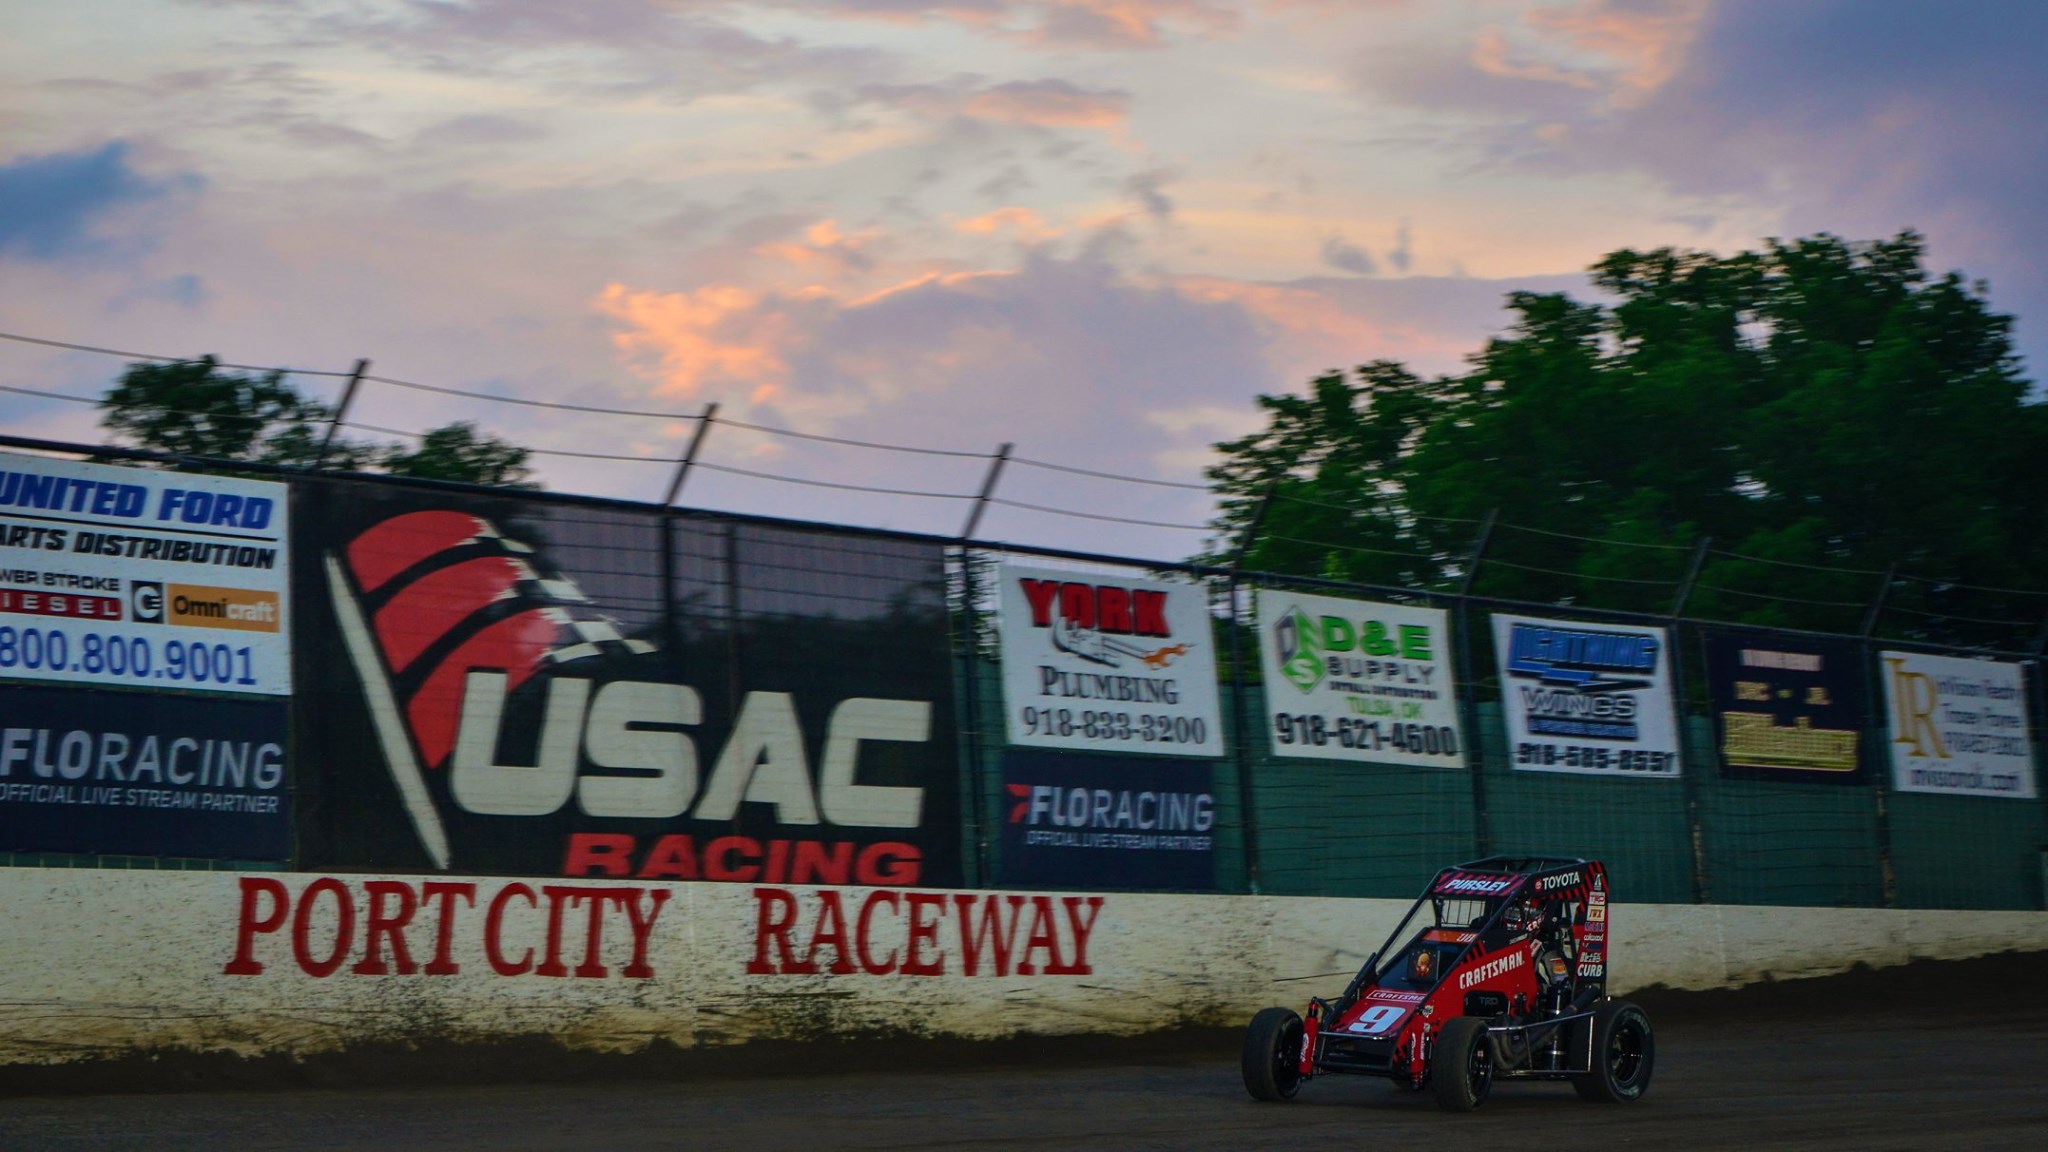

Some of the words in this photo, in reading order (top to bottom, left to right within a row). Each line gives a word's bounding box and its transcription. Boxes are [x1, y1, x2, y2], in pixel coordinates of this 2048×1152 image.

[157, 488, 273, 529] FORD
[73, 531, 277, 569] DISTRIBUTION
[43, 572, 120, 591] STROKE
[174, 595, 277, 622] Omnicraft
[1019, 577, 1172, 638] YORK
[0, 626, 256, 685] 800.800.9001
[1319, 615, 1433, 661] D&E
[1038, 666, 1179, 705] PLUMBING
[1327, 656, 1435, 684] SUPPLY
[1520, 685, 1637, 719] WINGS
[1022, 706, 1206, 745] 918-833-3200
[1275, 712, 1458, 756] 918-621-4600
[451, 671, 933, 828] USAC
[81, 787, 123, 806] LIVE
[126, 789, 197, 809] STREAM
[201, 792, 279, 813] PARTNER
[562, 832, 923, 885] RACING
[1445, 879, 1510, 892] PURSLEY
[1542, 871, 1580, 890] TOYOTA
[745, 887, 1104, 977] RACEWAY
[1459, 950, 1524, 989] CRAFTSMAN
[1577, 964, 1602, 977] CURB
[1373, 992, 1426, 1001] CRAFTSMA
[1348, 1005, 1406, 1033] 9
